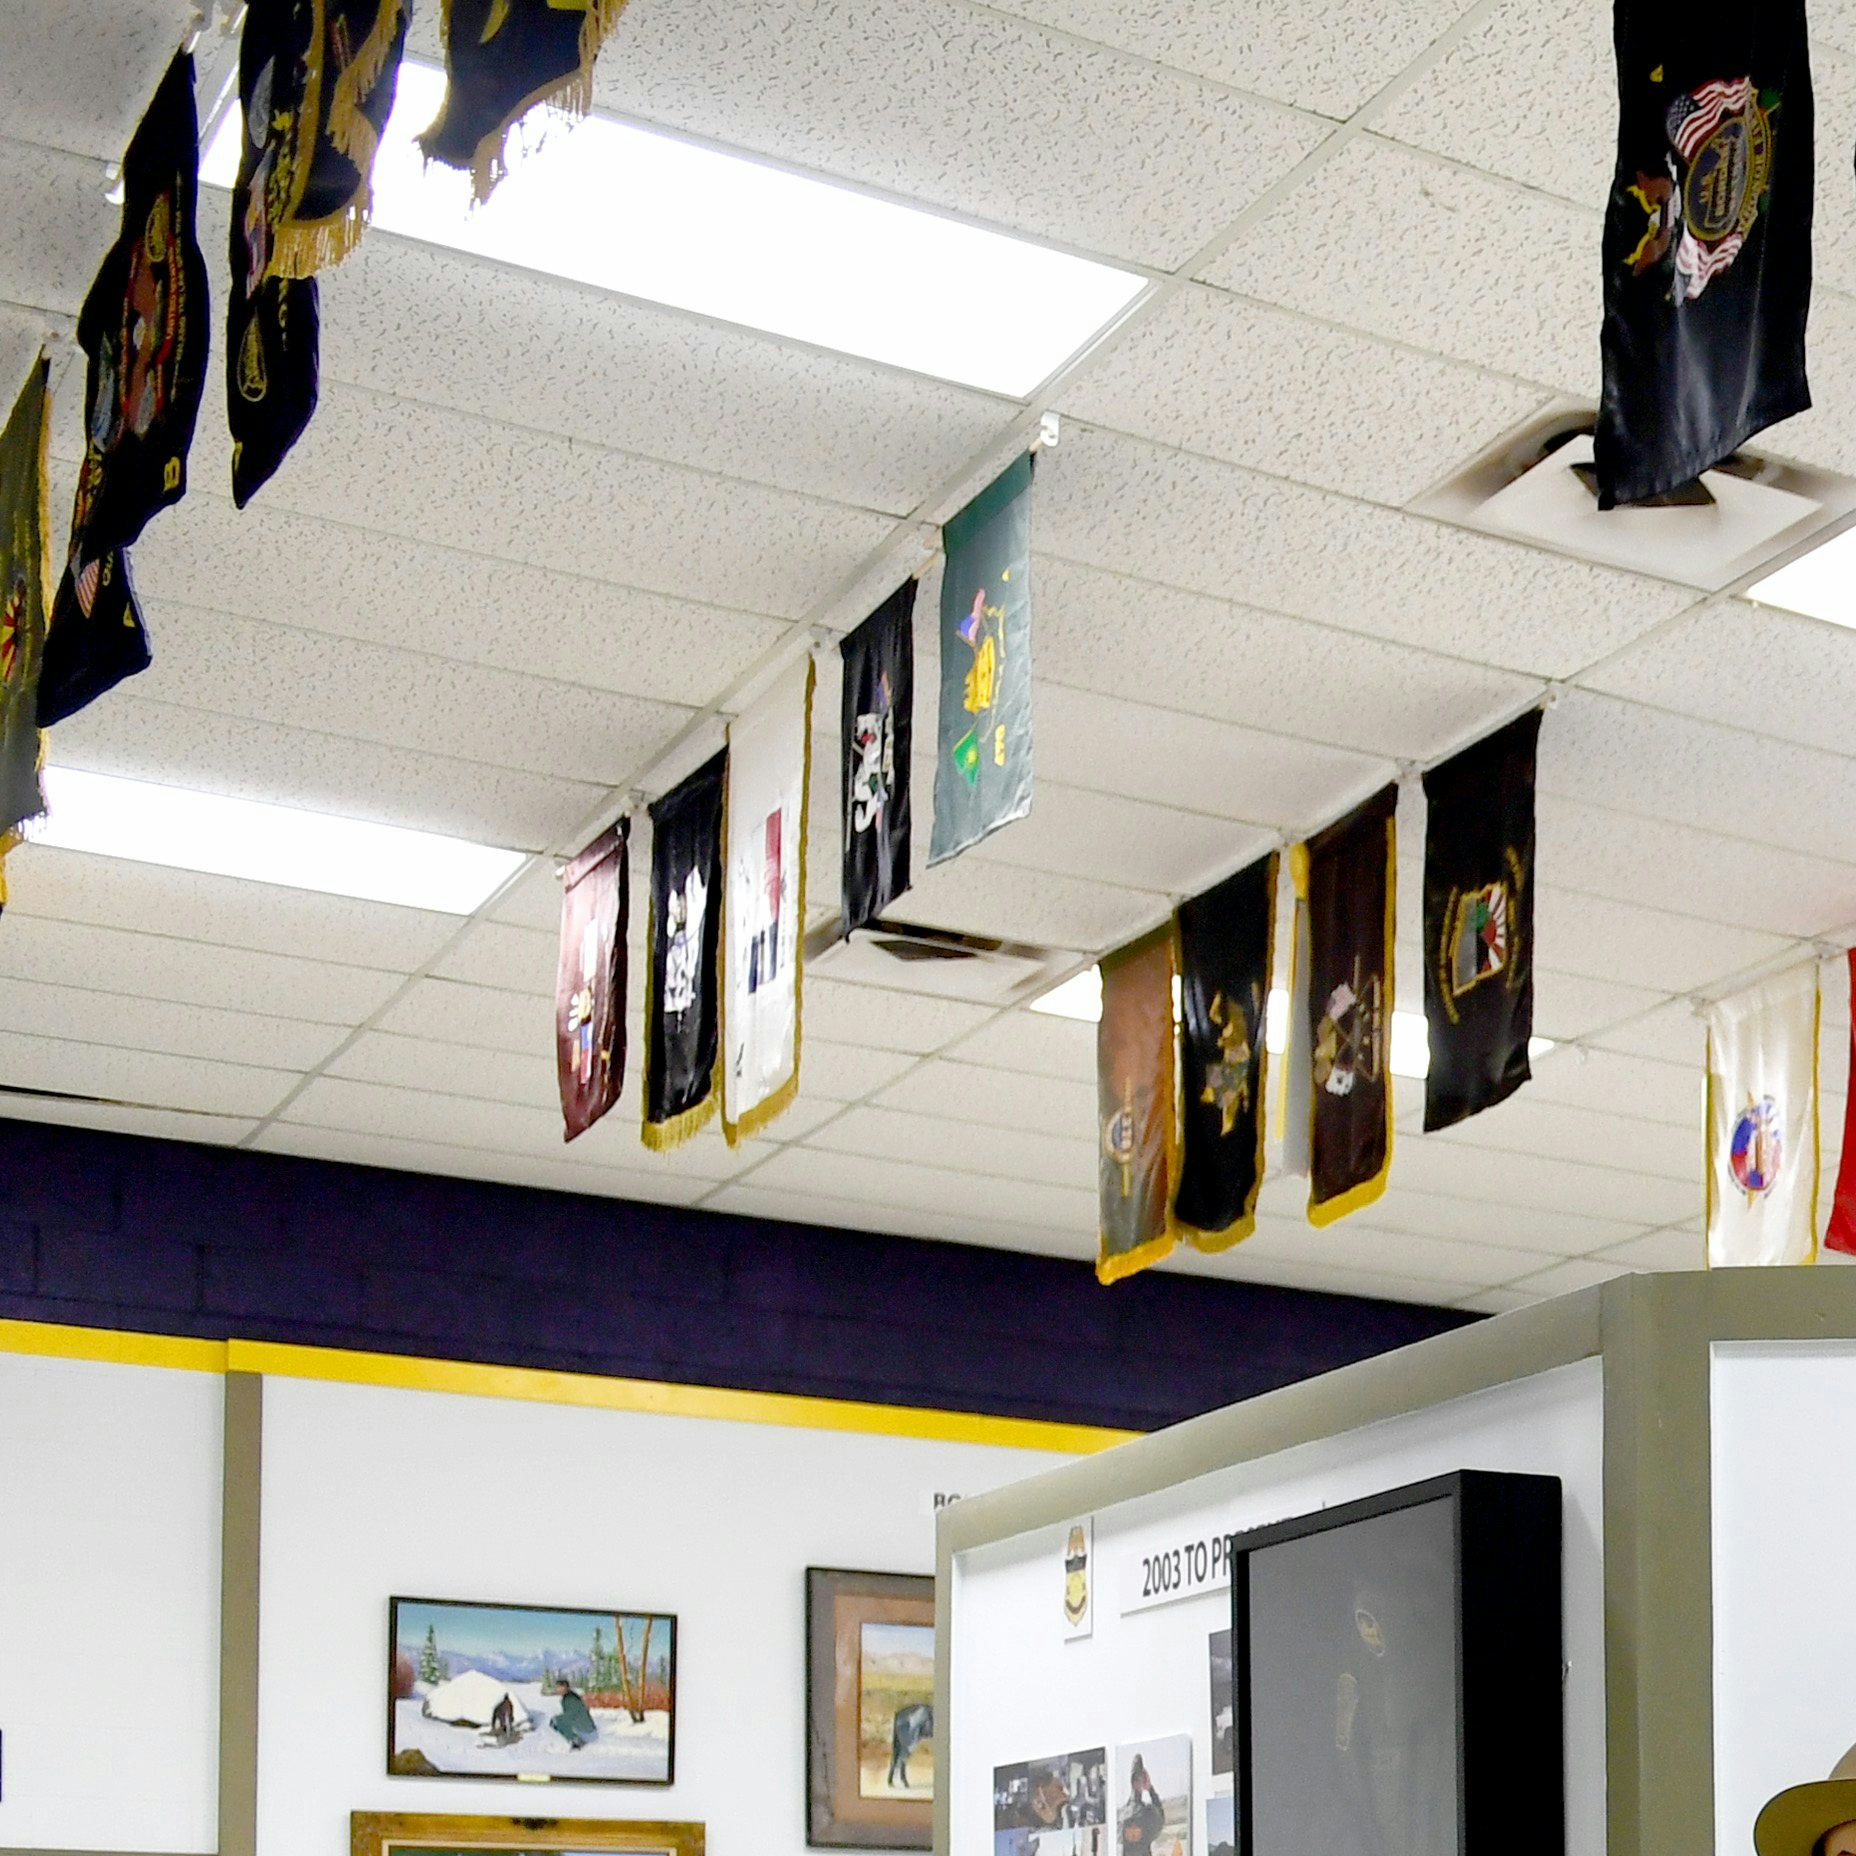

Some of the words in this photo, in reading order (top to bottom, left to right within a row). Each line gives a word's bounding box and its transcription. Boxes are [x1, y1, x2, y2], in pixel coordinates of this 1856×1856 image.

[163, 456, 181, 491] B
[1142, 1556, 1182, 1597] 2003
[1185, 1541, 1208, 1586] TO
